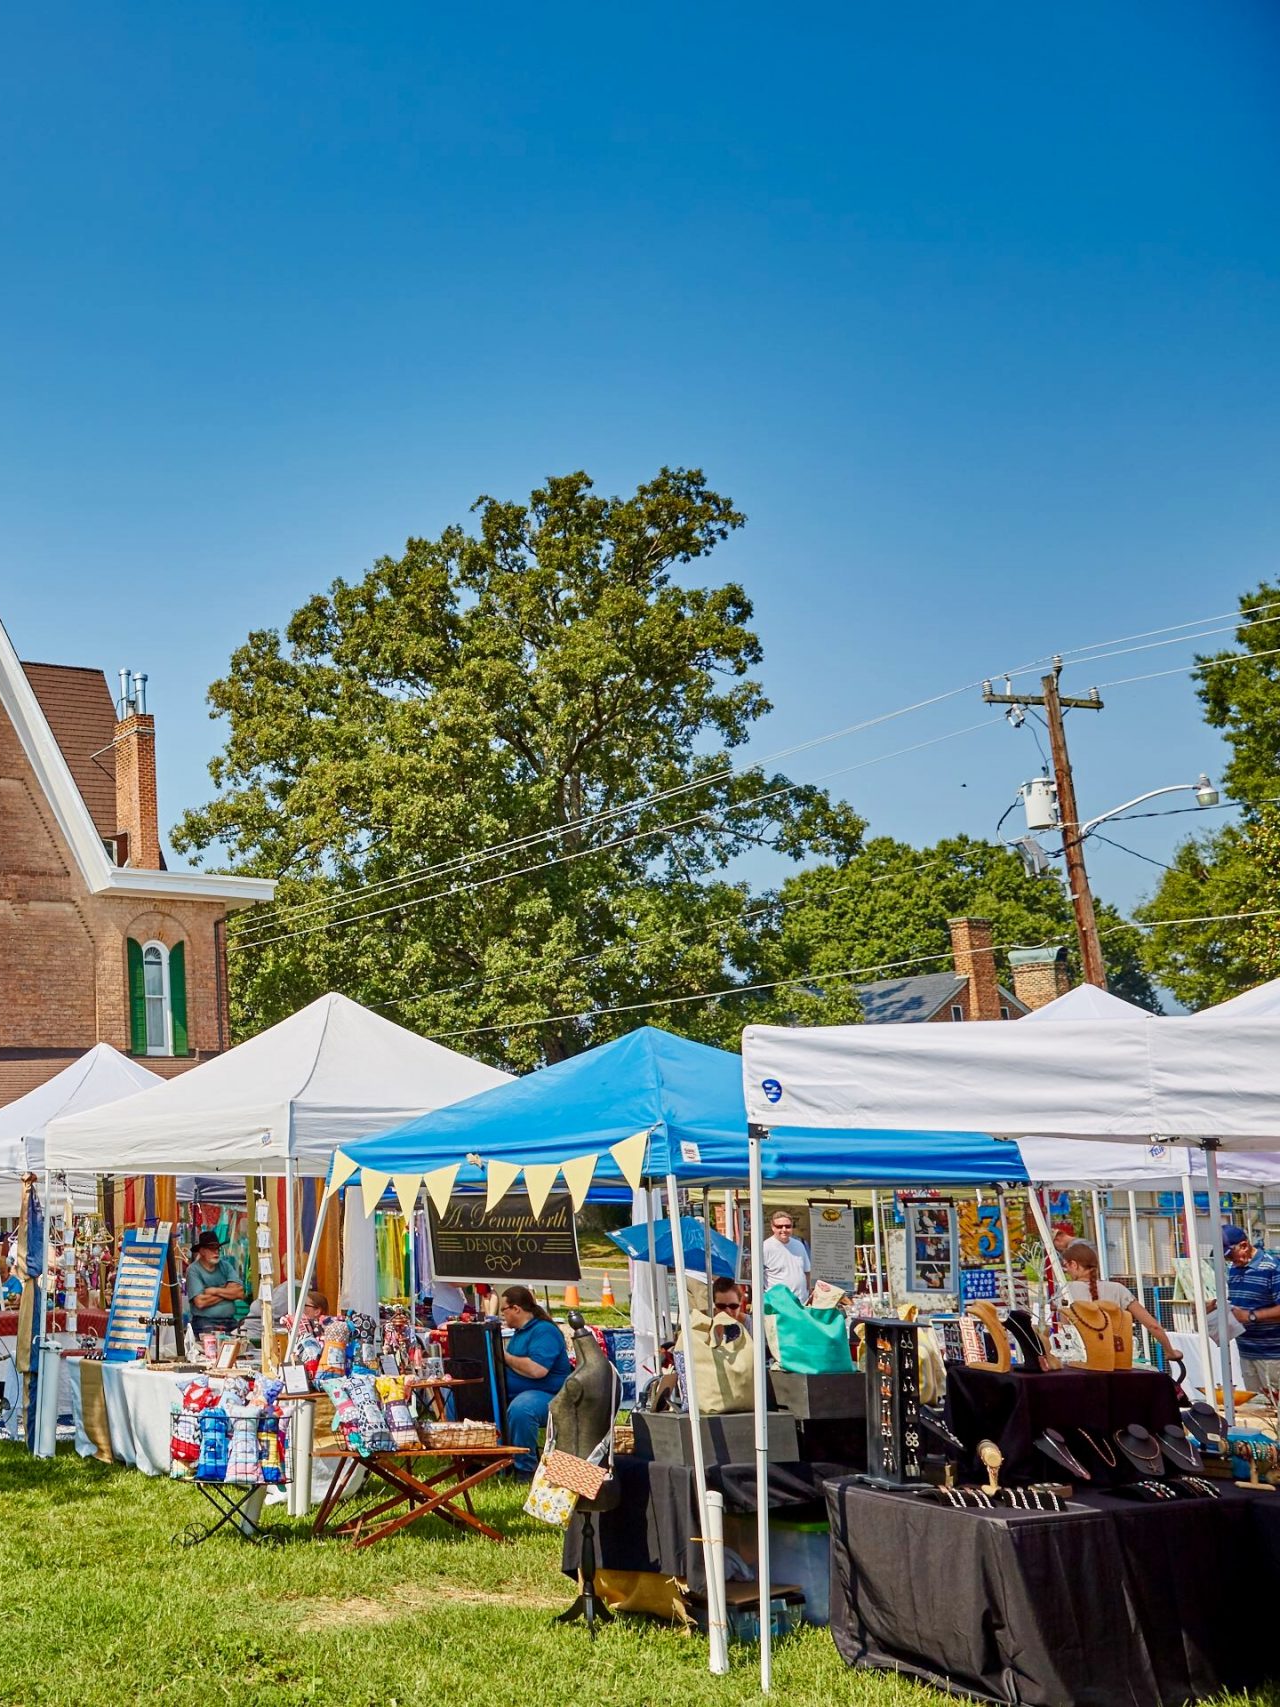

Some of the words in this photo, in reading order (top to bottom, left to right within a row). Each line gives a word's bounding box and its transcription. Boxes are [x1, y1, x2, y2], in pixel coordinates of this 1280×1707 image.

[465, 1237, 512, 1253] DESIGN
[517, 1238, 541, 1253] CO.
[977, 1205, 1004, 1258] 3
